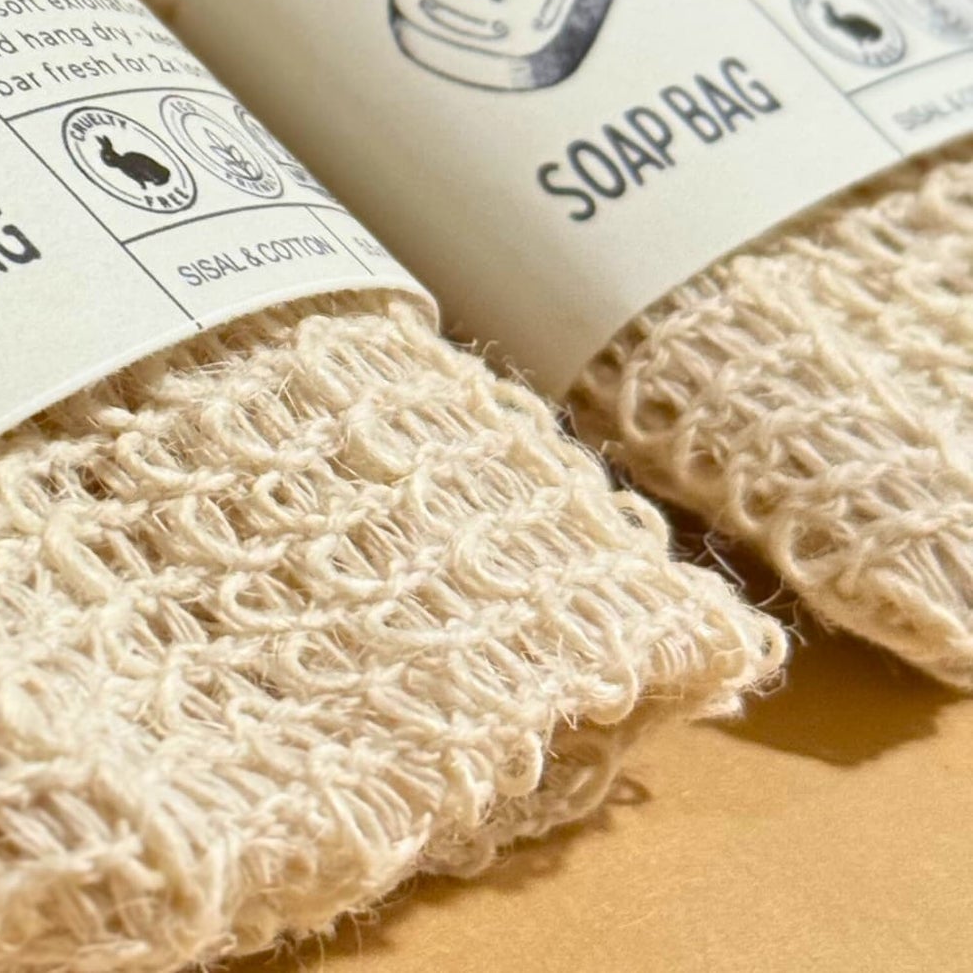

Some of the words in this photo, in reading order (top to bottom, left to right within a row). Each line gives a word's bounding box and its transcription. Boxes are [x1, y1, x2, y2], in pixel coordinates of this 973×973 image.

[16, 27, 94, 50] hang
[95, 21, 133, 47] dry
[41, 55, 117, 84] fresh
[111, 52, 151, 74] for
[147, 53, 177, 75] 2x
[69, 112, 128, 143] CRUELTY
[536, 105, 677, 222] SOAP
[658, 55, 781, 145] BAG
[143, 186, 191, 209] FREE
[177, 251, 246, 288] SISAL
[239, 245, 266, 269] &
[257, 233, 338, 263] COTTON
